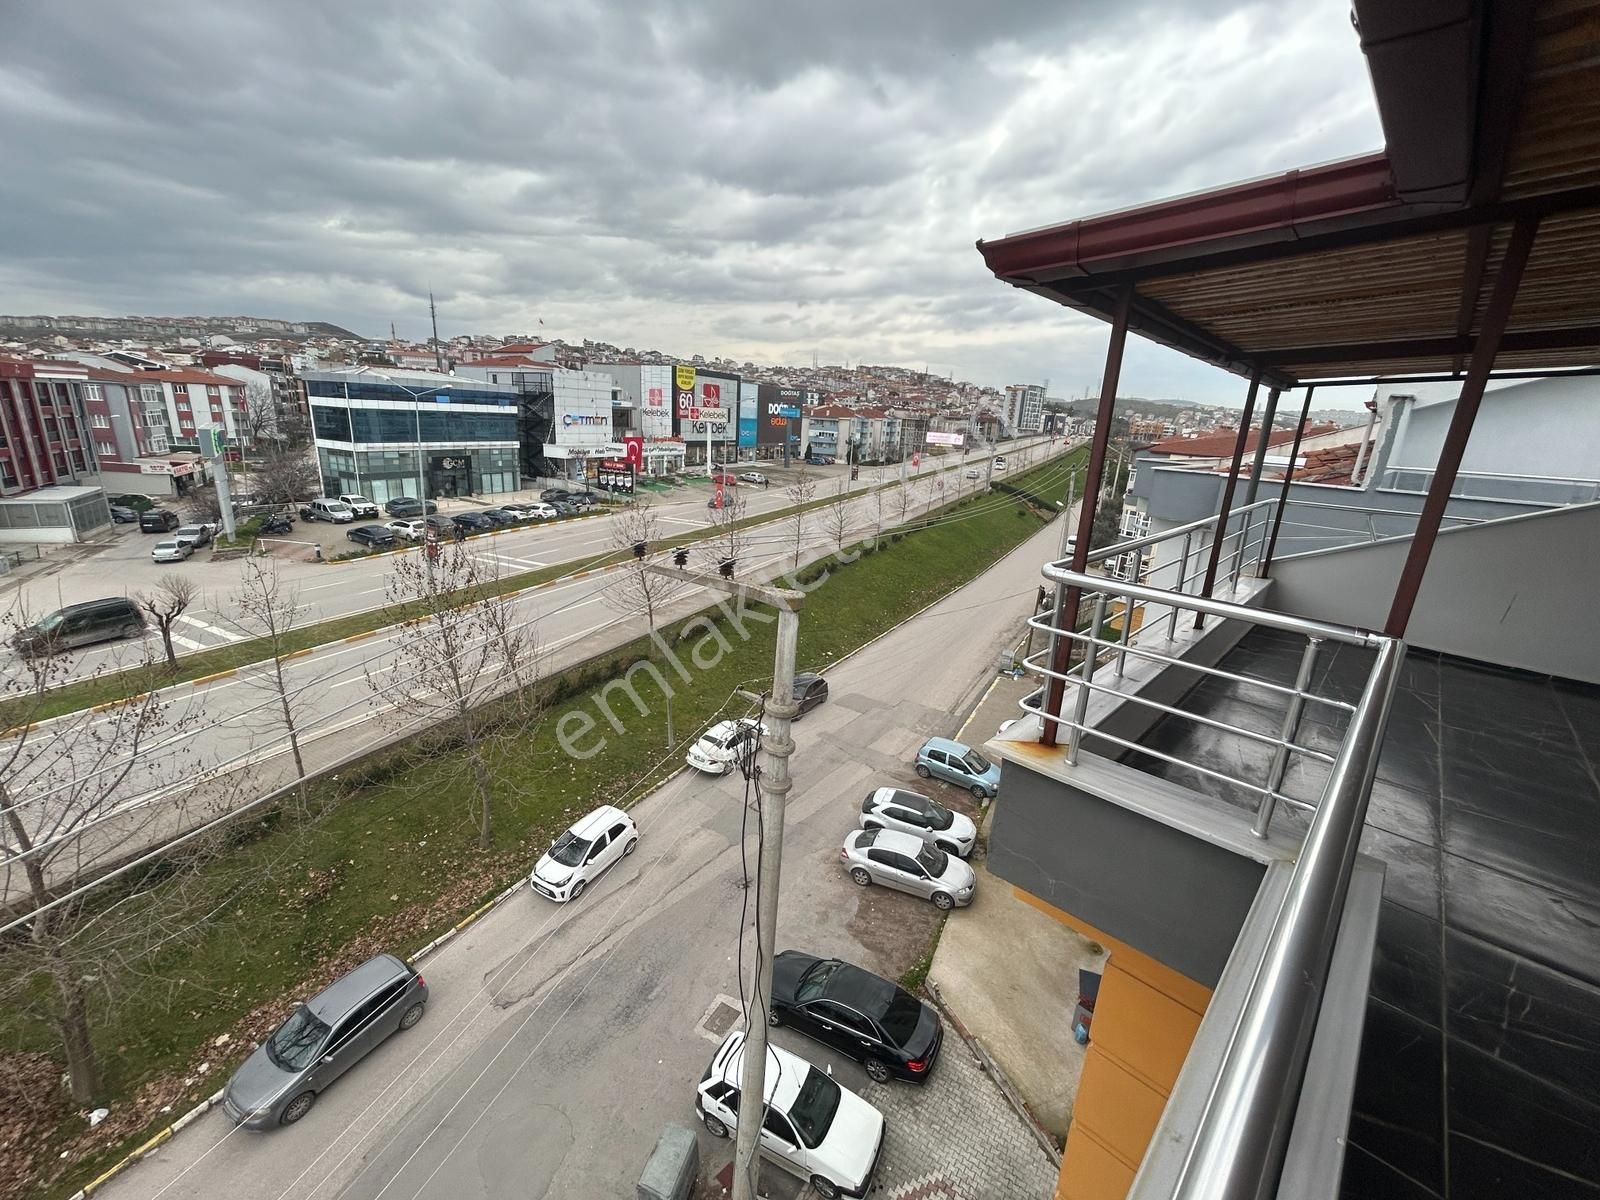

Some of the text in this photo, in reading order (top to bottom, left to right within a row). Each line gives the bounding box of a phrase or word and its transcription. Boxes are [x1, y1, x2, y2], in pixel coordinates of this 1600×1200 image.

[679, 392, 693, 411] 60
[642, 407, 670, 418] Kelebek
[699, 410, 727, 420] Kelebek
[692, 420, 728, 434] Kelbek
